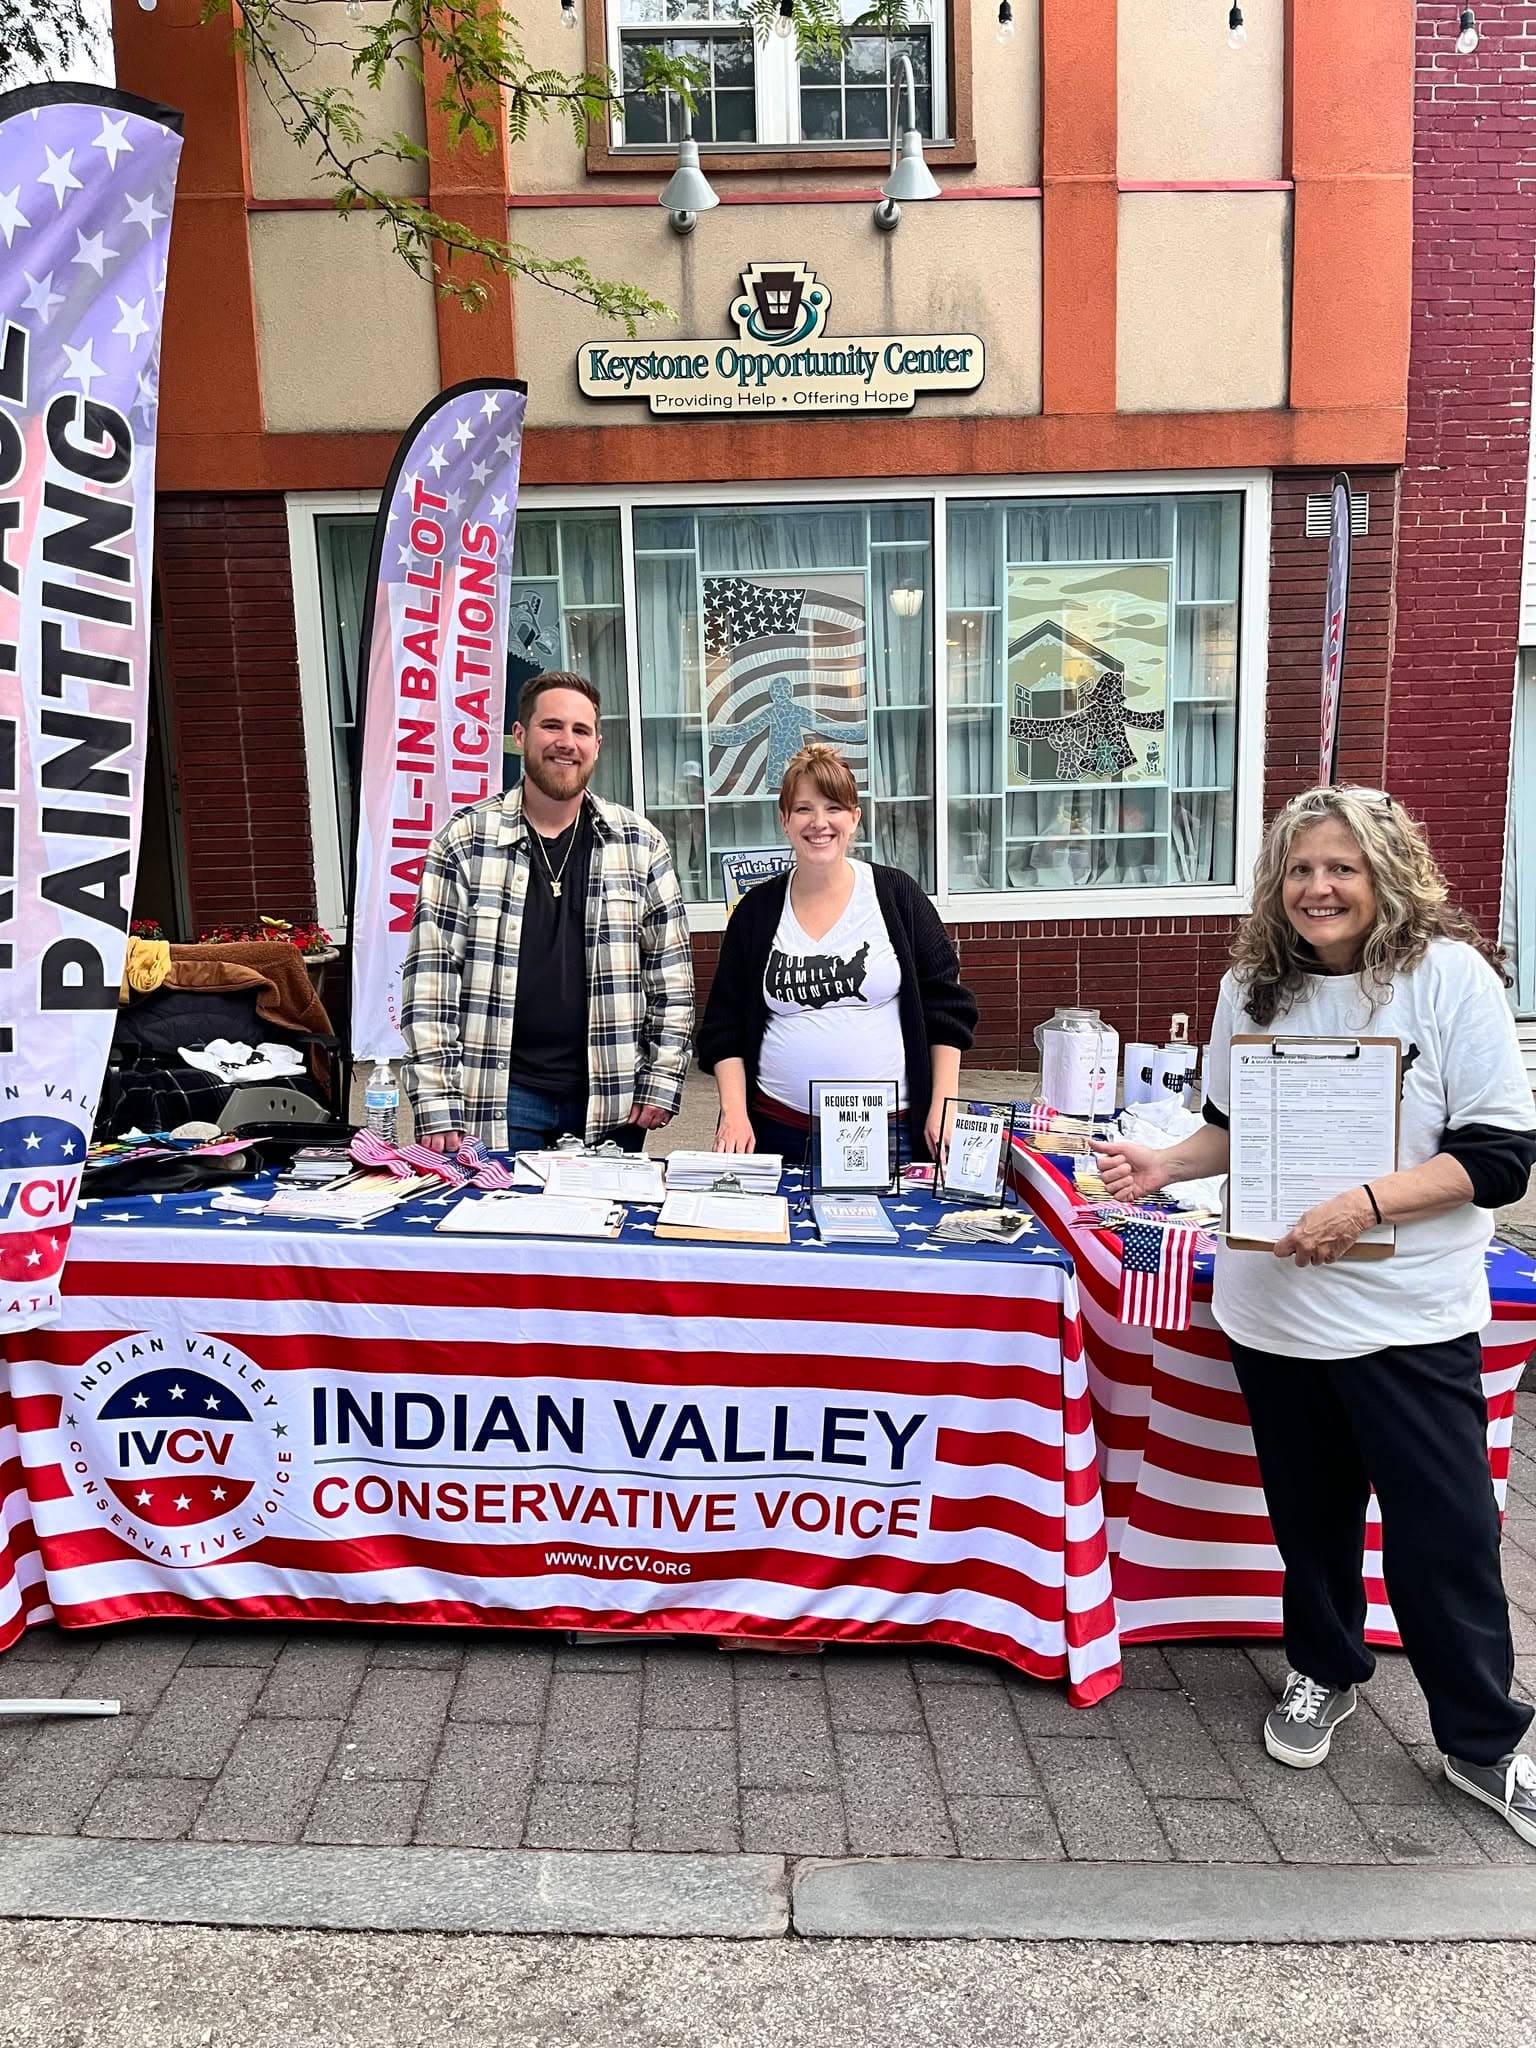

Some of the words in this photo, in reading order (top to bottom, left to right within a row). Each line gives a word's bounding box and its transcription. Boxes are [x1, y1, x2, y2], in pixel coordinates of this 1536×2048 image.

[590, 348, 709, 389] Keystone
[716, 345, 877, 387] Opportunity
[884, 343, 972, 375] Center
[656, 394, 732, 408] Providing
[738, 393, 776, 407] Help
[793, 391, 859, 405] Offering
[865, 390, 909, 404] Hope
[400, 479, 448, 702] BALLOT
[450, 519, 499, 806] LICATIONS
[41, 395, 133, 1010] PAINTING
[389, 717, 435, 932] MAIL-IN
[775, 958, 837, 985] FAMILY
[776, 977, 854, 1002] COUNTRY
[825, 1095, 859, 1107] REQUEST
[862, 1095, 883, 1107] YOUR
[839, 1111, 870, 1122] MAIL-IN
[955, 1118, 988, 1133] REGISTER
[990, 1122, 999, 1134] TO
[73, 1338, 164, 1402] INDIAN
[185, 1338, 278, 1408] VALLEY
[118, 1428, 234, 1467] IVCV
[313, 1387, 584, 1454] INDIAN
[613, 1399, 929, 1470] VALLEY
[70, 1441, 246, 1558] CONSERVATIVE
[252, 1451, 292, 1527] VOICE
[314, 1476, 736, 1533] CONSERVATIVE
[760, 1491, 920, 1539] VOICE
